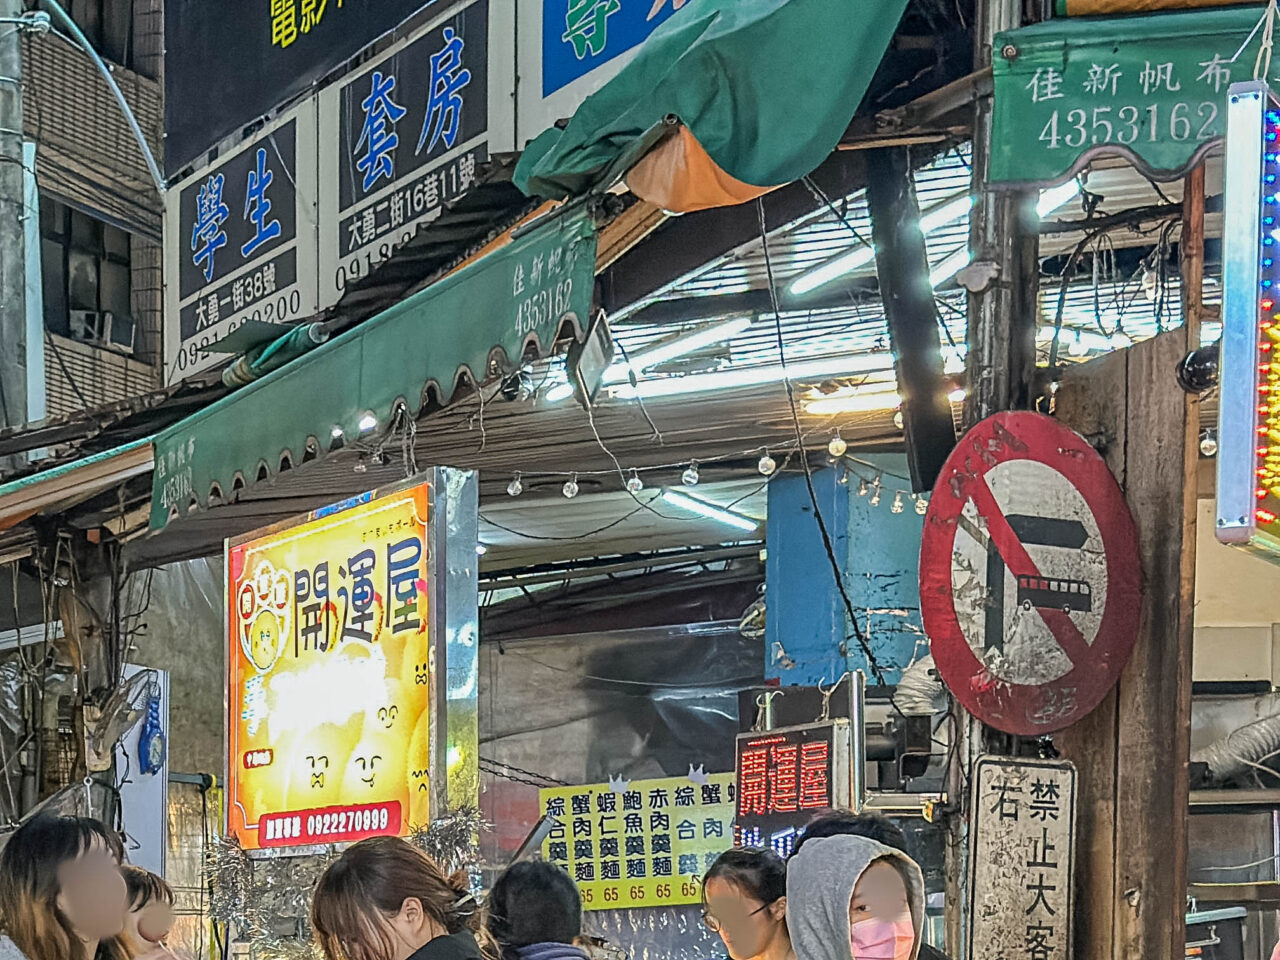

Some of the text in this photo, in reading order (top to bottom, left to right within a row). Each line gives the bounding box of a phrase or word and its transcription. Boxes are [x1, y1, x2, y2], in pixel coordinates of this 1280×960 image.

[354, 27, 471, 192] 套房
[1026, 53, 1232, 104] 佳新帆布
[1038, 101, 1219, 149] 4353162
[191, 147, 281, 283] 學生
[196, 262, 276, 332] 大勇一街38號
[515, 278, 572, 337] 4353162
[294, 537, 422, 659] 開運屋
[740, 741, 828, 816] 開運屋
[546, 797, 569, 872] 綜合羹
[604, 888, 619, 901] 65
[630, 886, 645, 900] 65
[656, 884, 671, 898] 65
[682, 882, 697, 896] 65
